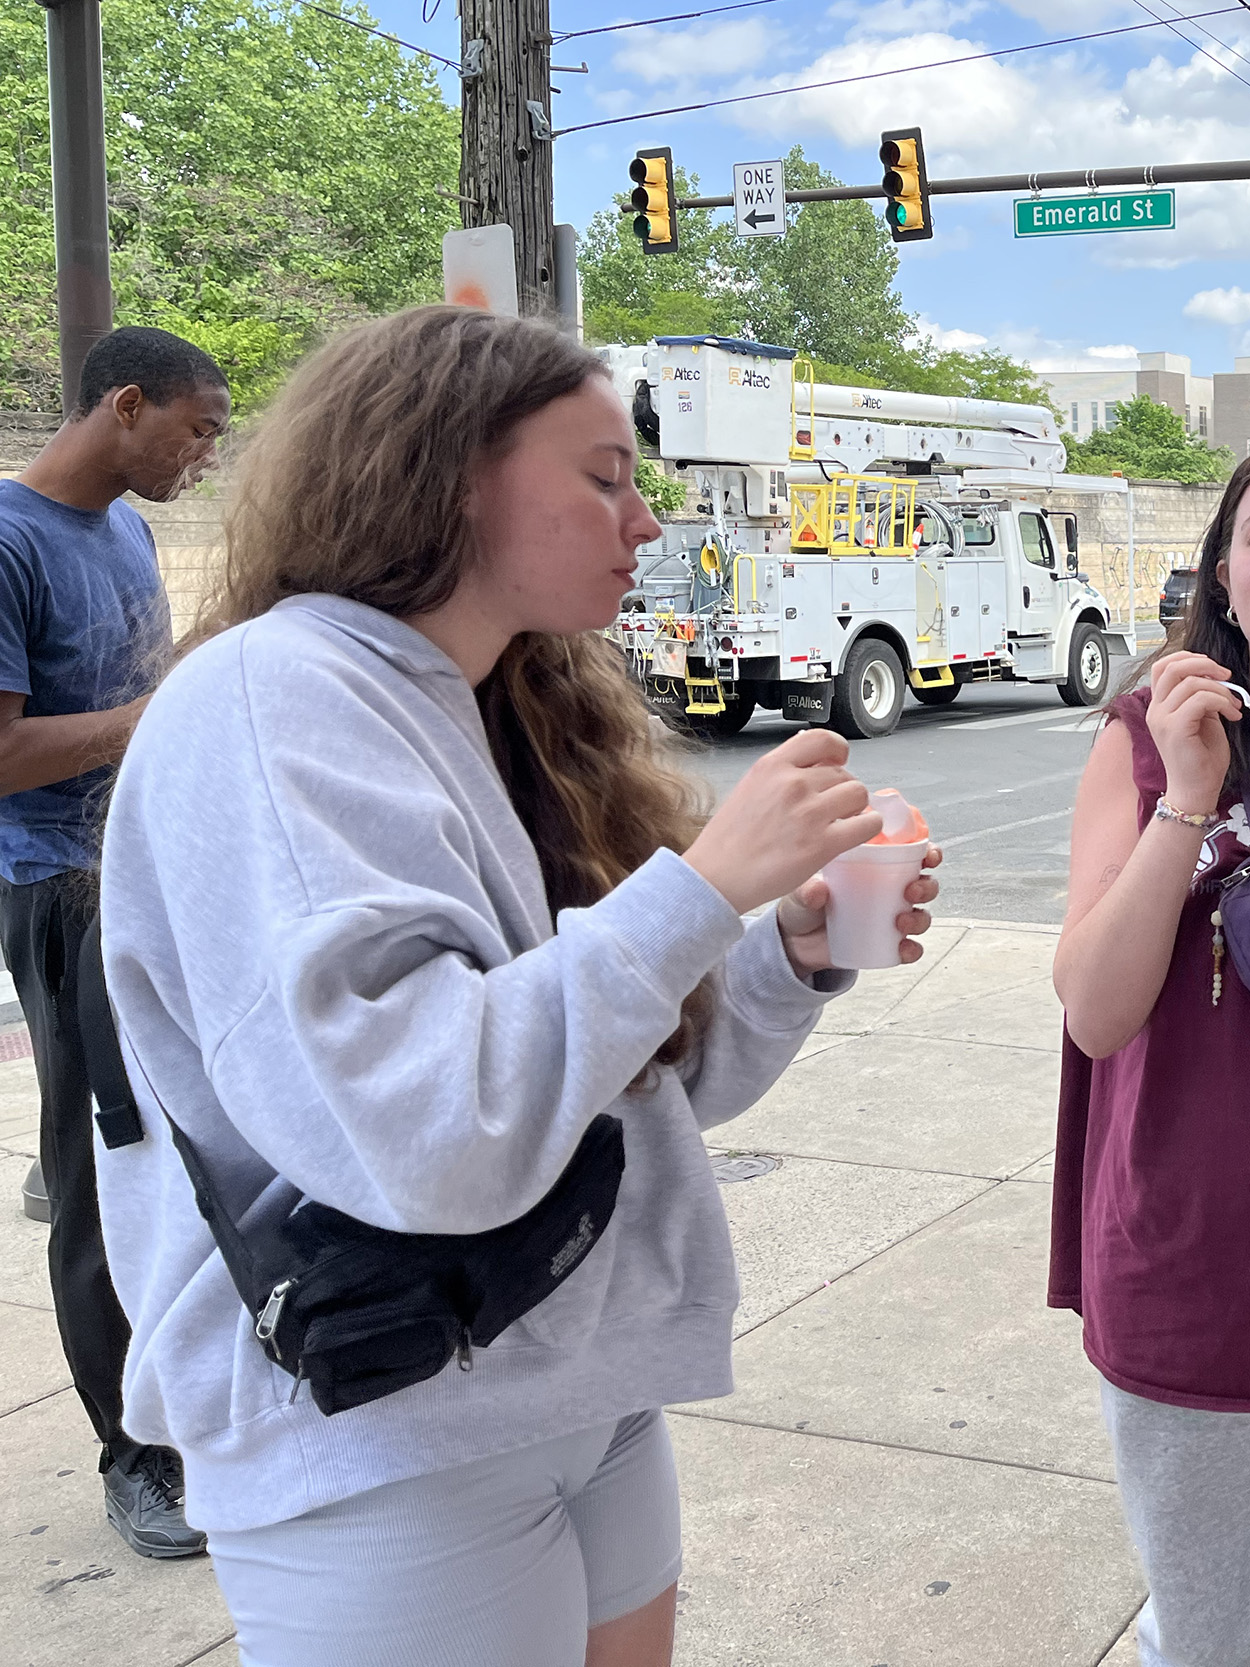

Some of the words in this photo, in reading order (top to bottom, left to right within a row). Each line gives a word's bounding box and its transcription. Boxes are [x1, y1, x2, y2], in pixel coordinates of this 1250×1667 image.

[743, 168, 774, 186] ONE
[743, 187, 775, 205] WAY
[1032, 200, 1122, 226] Emerald
[1132, 199, 1154, 221] St
[674, 367, 701, 381] Altec
[742, 369, 771, 389] Altec
